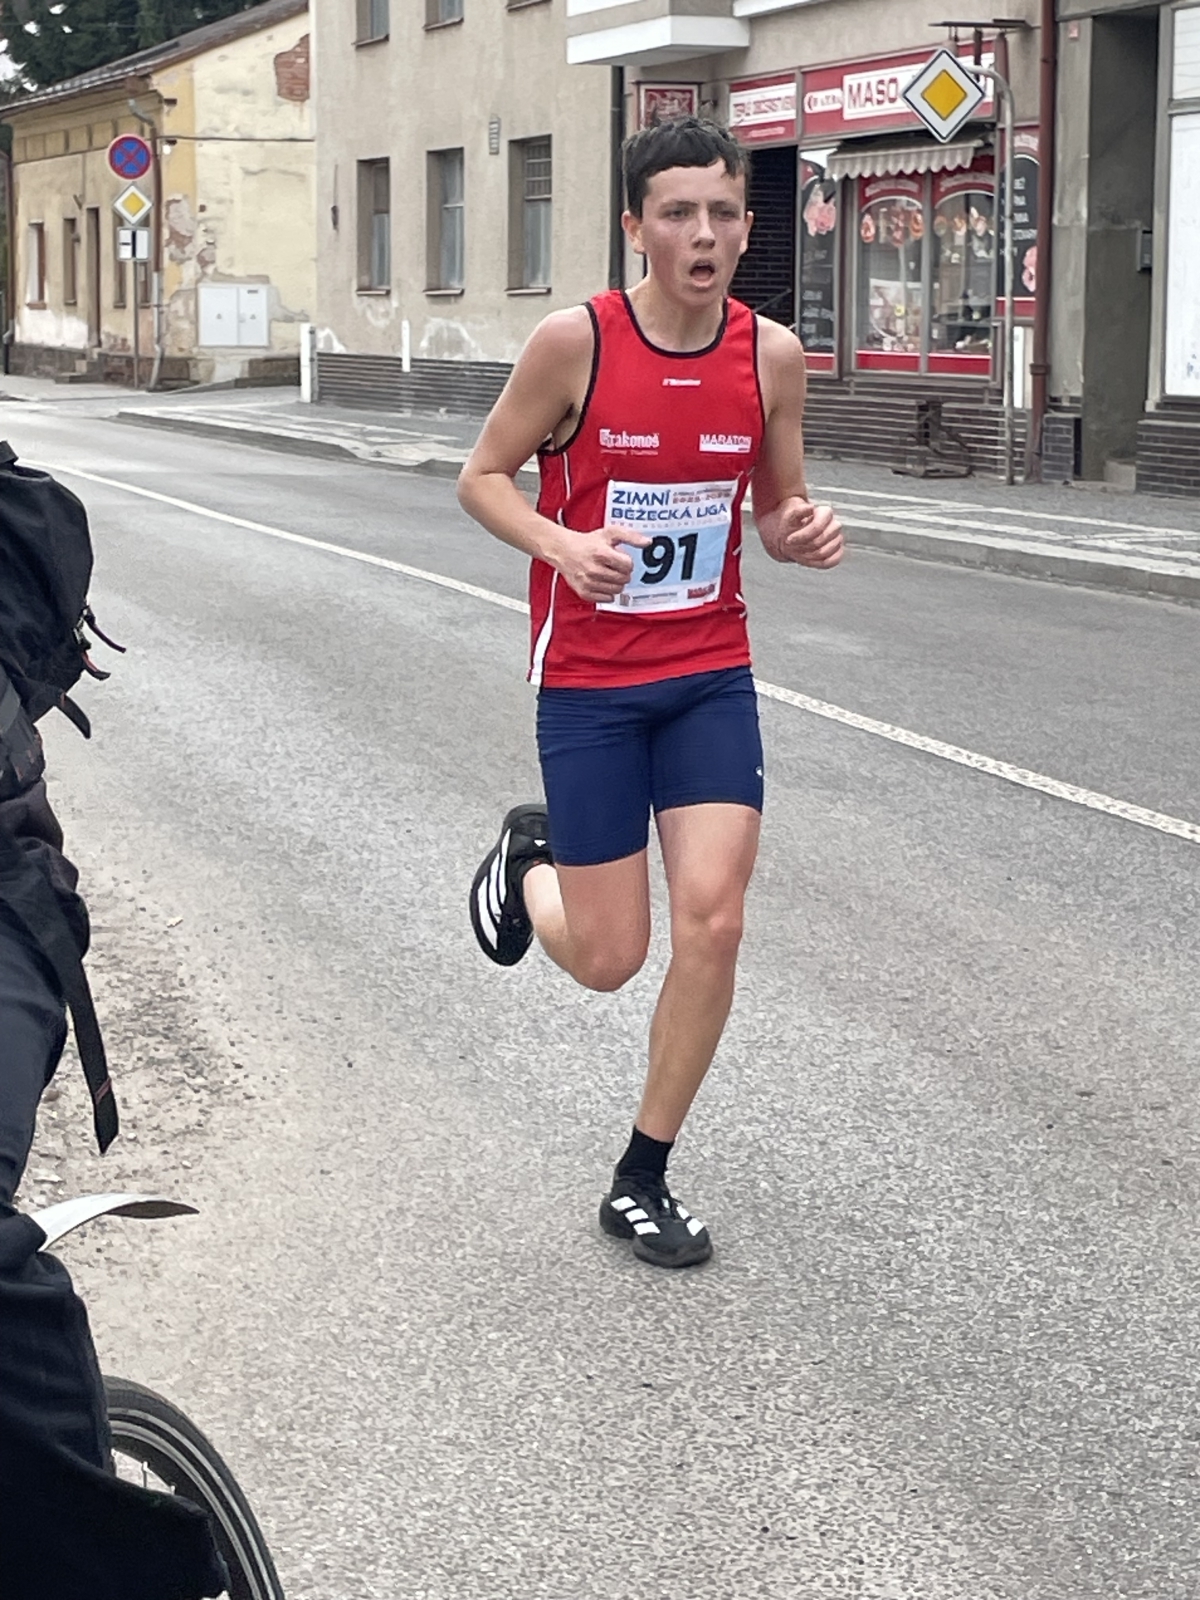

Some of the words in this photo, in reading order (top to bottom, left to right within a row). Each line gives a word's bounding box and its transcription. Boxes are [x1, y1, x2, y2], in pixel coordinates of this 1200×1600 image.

[848, 77, 898, 109] MASO
[612, 489, 671, 506] ZIMNÍ
[611, 506, 693, 521] BĚŽECKÁ
[696, 503, 728, 518] LIGA
[640, 532, 698, 585] 91
